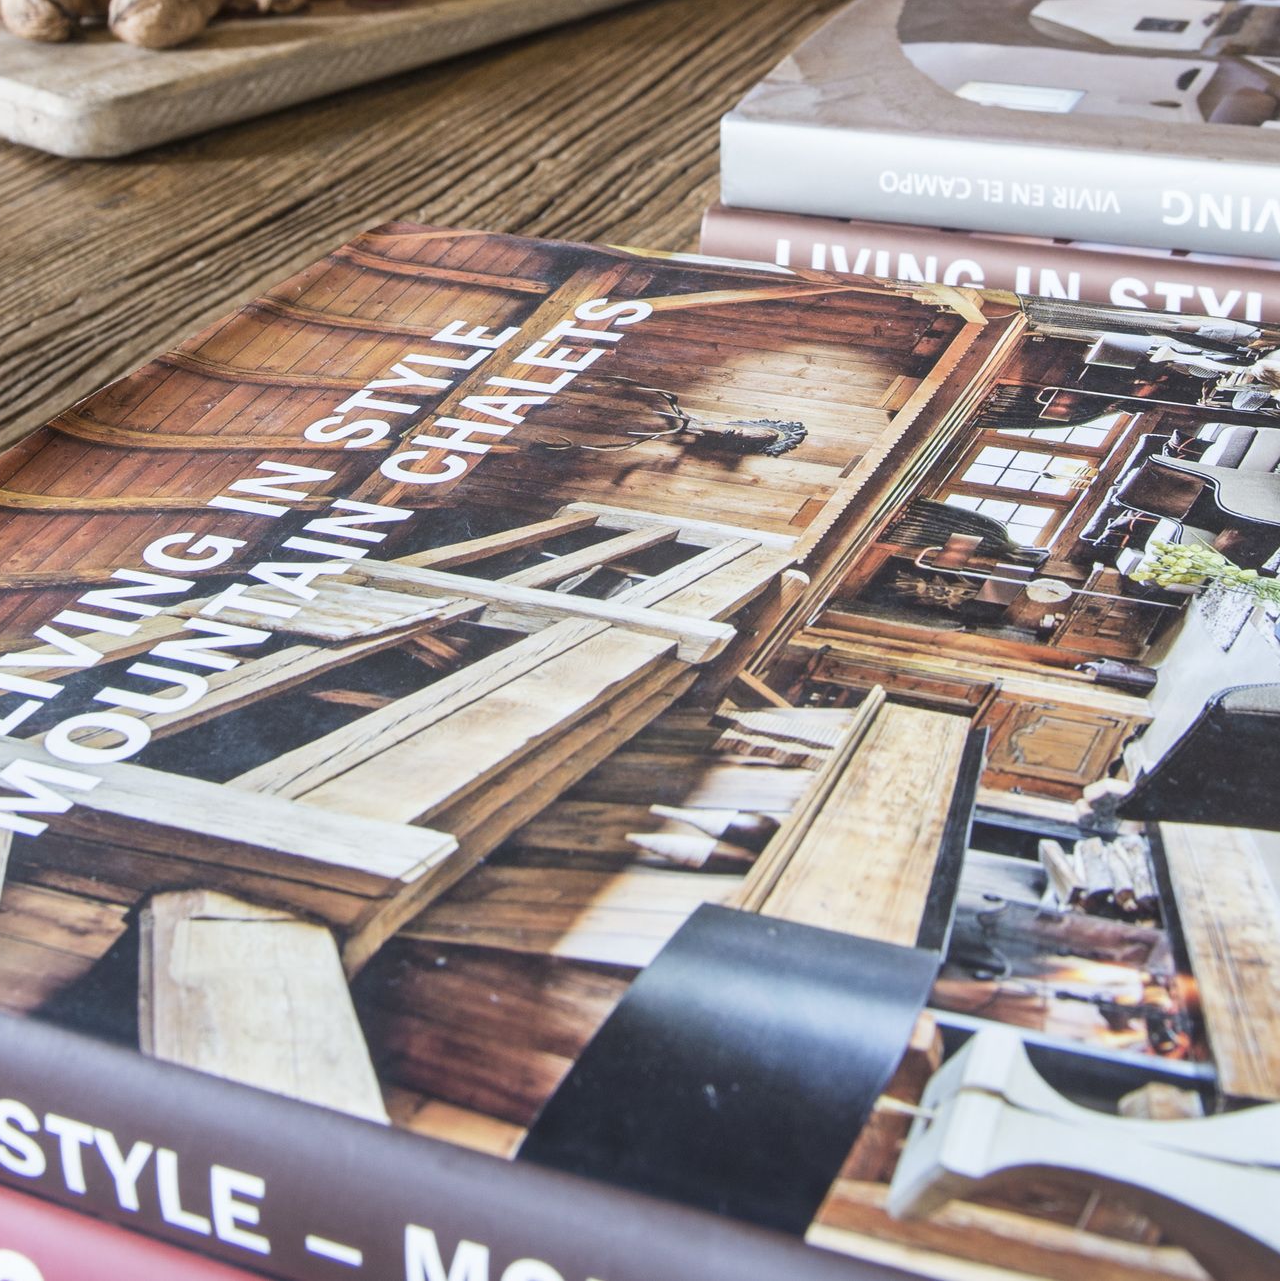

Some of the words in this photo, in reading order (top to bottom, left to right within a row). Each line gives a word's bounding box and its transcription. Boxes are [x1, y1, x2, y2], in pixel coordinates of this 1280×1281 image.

[879, 170, 972, 197] CAMPO
[978, 178, 1005, 203] EL
[1012, 182, 1045, 207] EN
[1053, 185, 1121, 213] VIVIR
[380, 297, 654, 485] CHALETS
[207, 460, 336, 517] IN
[303, 320, 520, 449] STYLE
